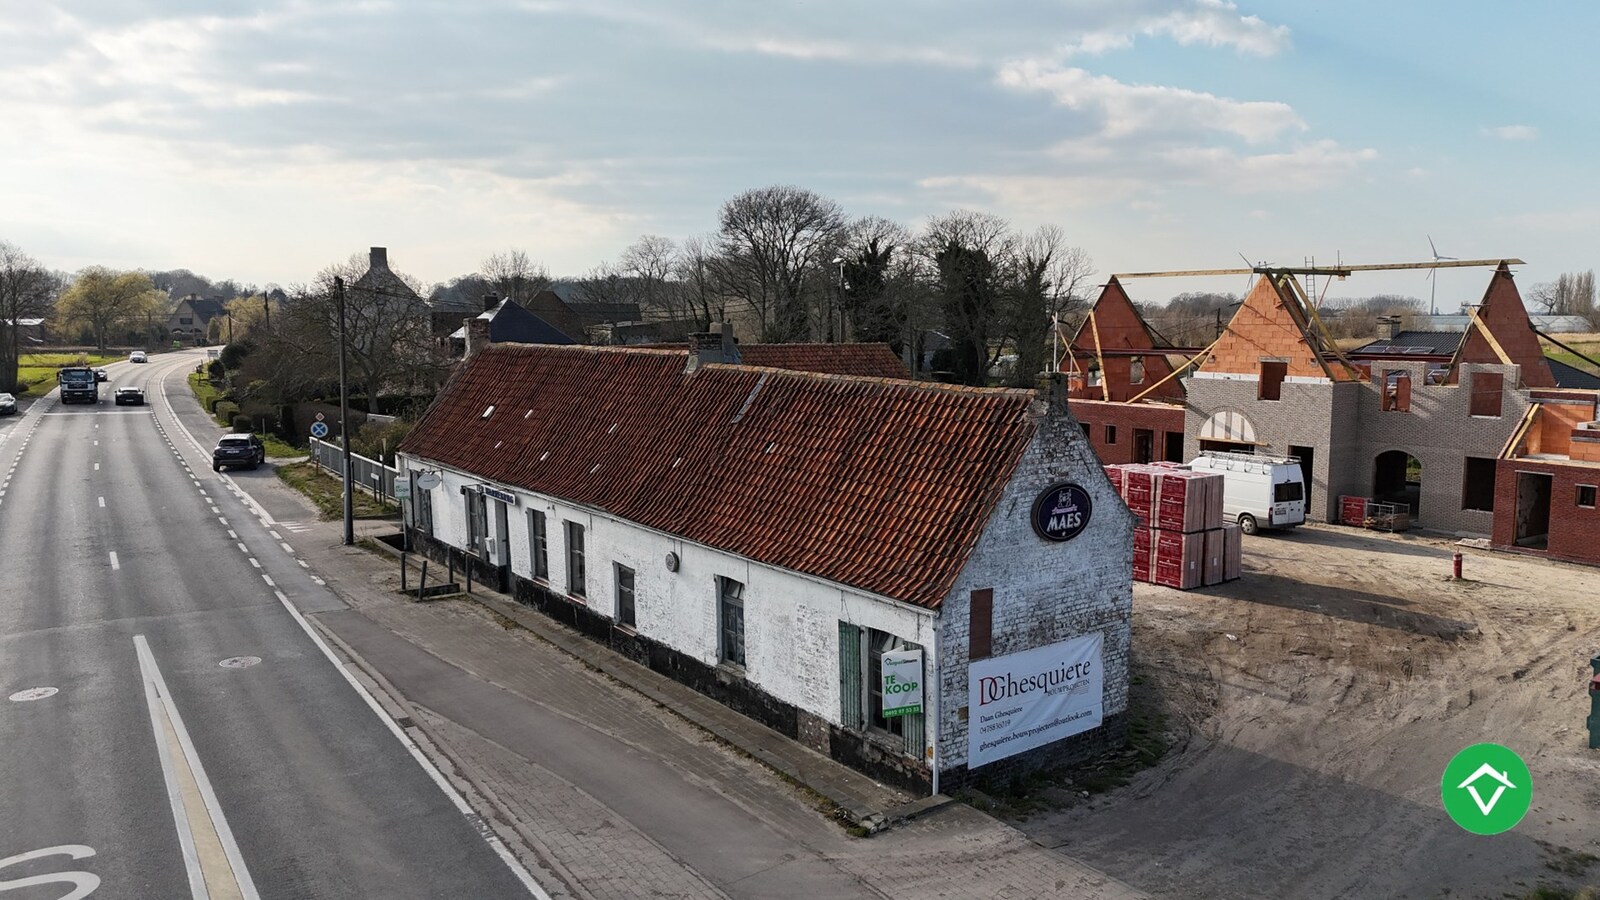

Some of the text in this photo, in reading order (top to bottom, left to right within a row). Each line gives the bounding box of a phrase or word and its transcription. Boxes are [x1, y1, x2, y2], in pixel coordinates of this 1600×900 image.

[1046, 511, 1082, 532] MAES
[884, 675, 896, 685] TE
[885, 682, 919, 695] KOOP
[980, 706, 1023, 723] Daan Ghesquiere
